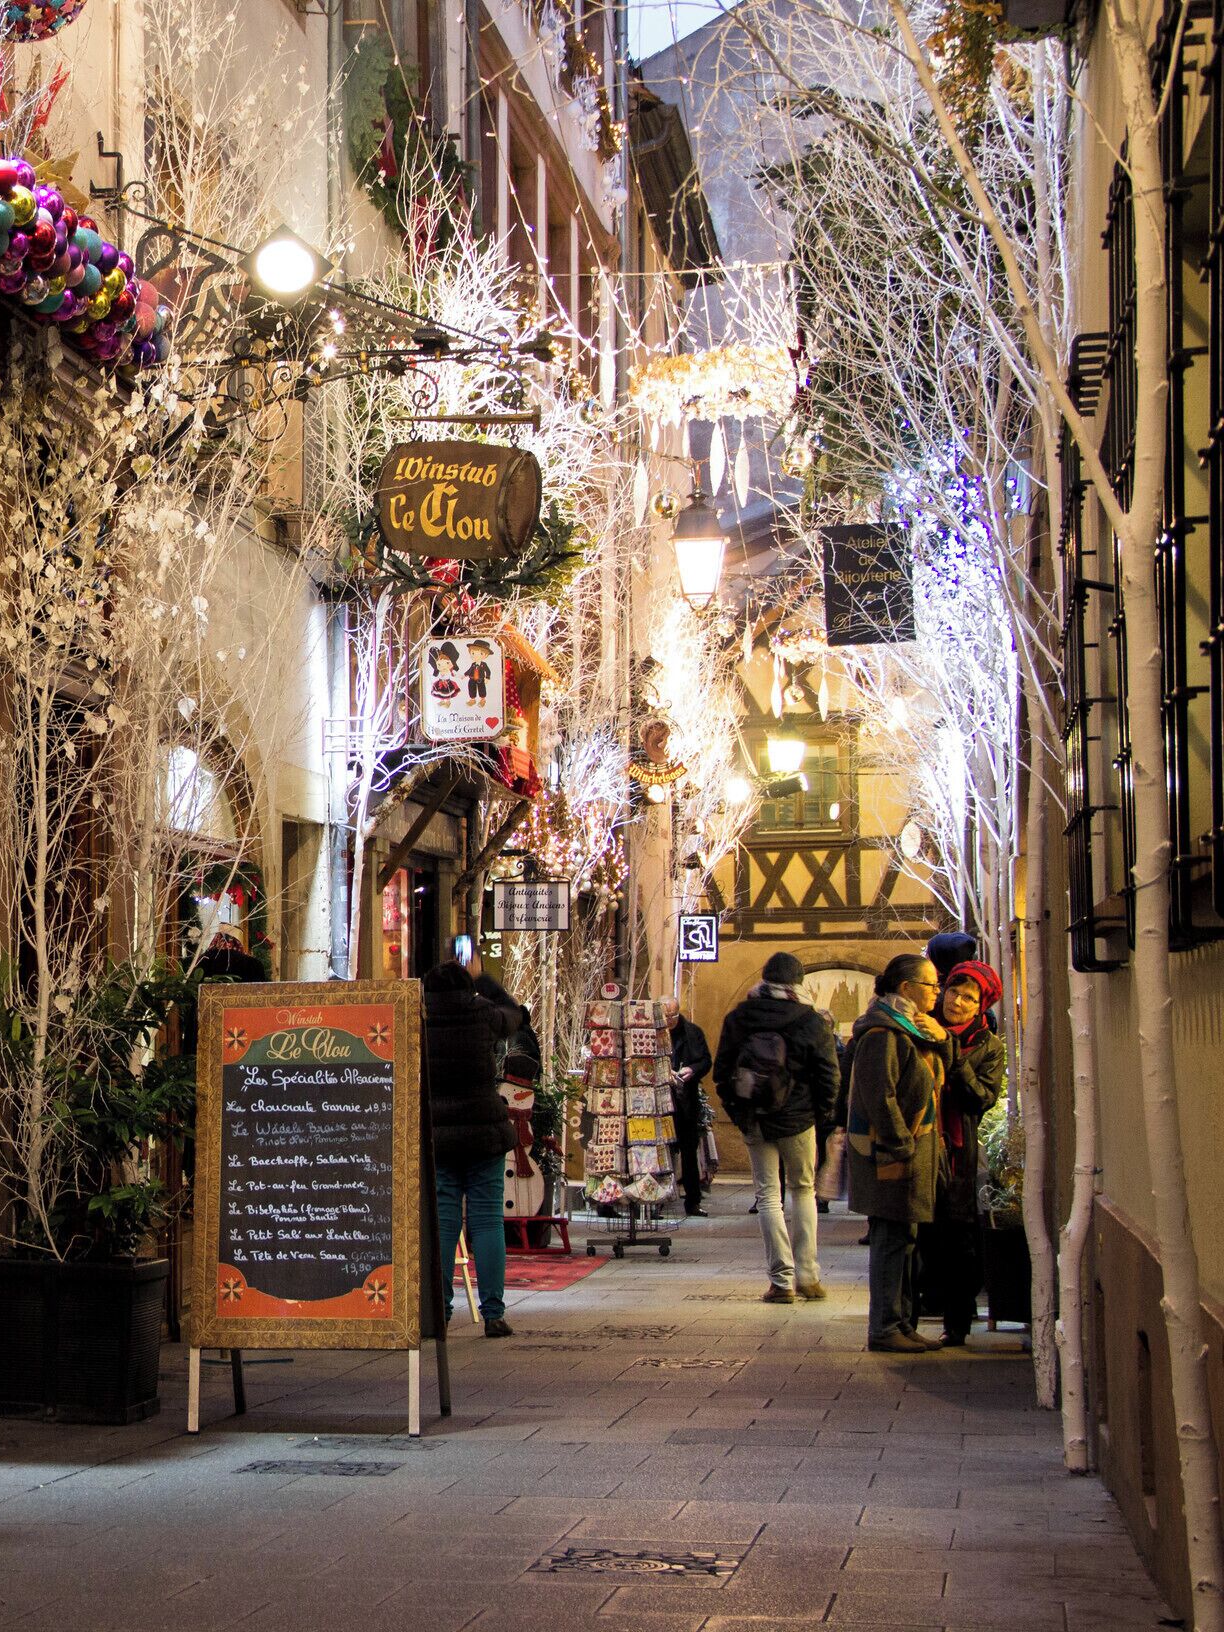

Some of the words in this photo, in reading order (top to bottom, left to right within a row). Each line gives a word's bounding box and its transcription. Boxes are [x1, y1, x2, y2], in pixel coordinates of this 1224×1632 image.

[393, 456, 497, 487] Winstub
[390, 493, 414, 531] Le
[420, 482, 492, 540] Clou
[848, 535, 888, 549] Atelier
[835, 568, 902, 587] Bijouterie
[463, 725, 484, 733] Gretel
[509, 888, 552, 898] Antiquités
[498, 900, 529, 911] Bijoux
[532, 901, 565, 909] Anciens
[276, 1009, 323, 1025] Winstub
[267, 1032, 302, 1060] Le
[301, 1027, 352, 1064] Clou
[225, 1101, 246, 1112] La
[251, 1100, 316, 1112] choucroute
[322, 1102, 361, 1112] Garnie
[231, 1121, 249, 1137] Le
[256, 1137, 286, 1146] Pinot
[228, 1155, 243, 1168] Le
[316, 1155, 349, 1164] Salade
[228, 1180, 243, 1192] Le
[246, 1180, 308, 1193] Pot-au-feu
[228, 1202, 243, 1215] Le
[230, 1229, 243, 1241] Le
[246, 1229, 273, 1241] Petit
[278, 1229, 301, 1239] Salé
[327, 1229, 369, 1241] Lentilles
[234, 1249, 248, 1261] La
[250, 1251, 273, 1261] Tête
[276, 1250, 288, 1259] de
[320, 1250, 348, 1261] Sauce
